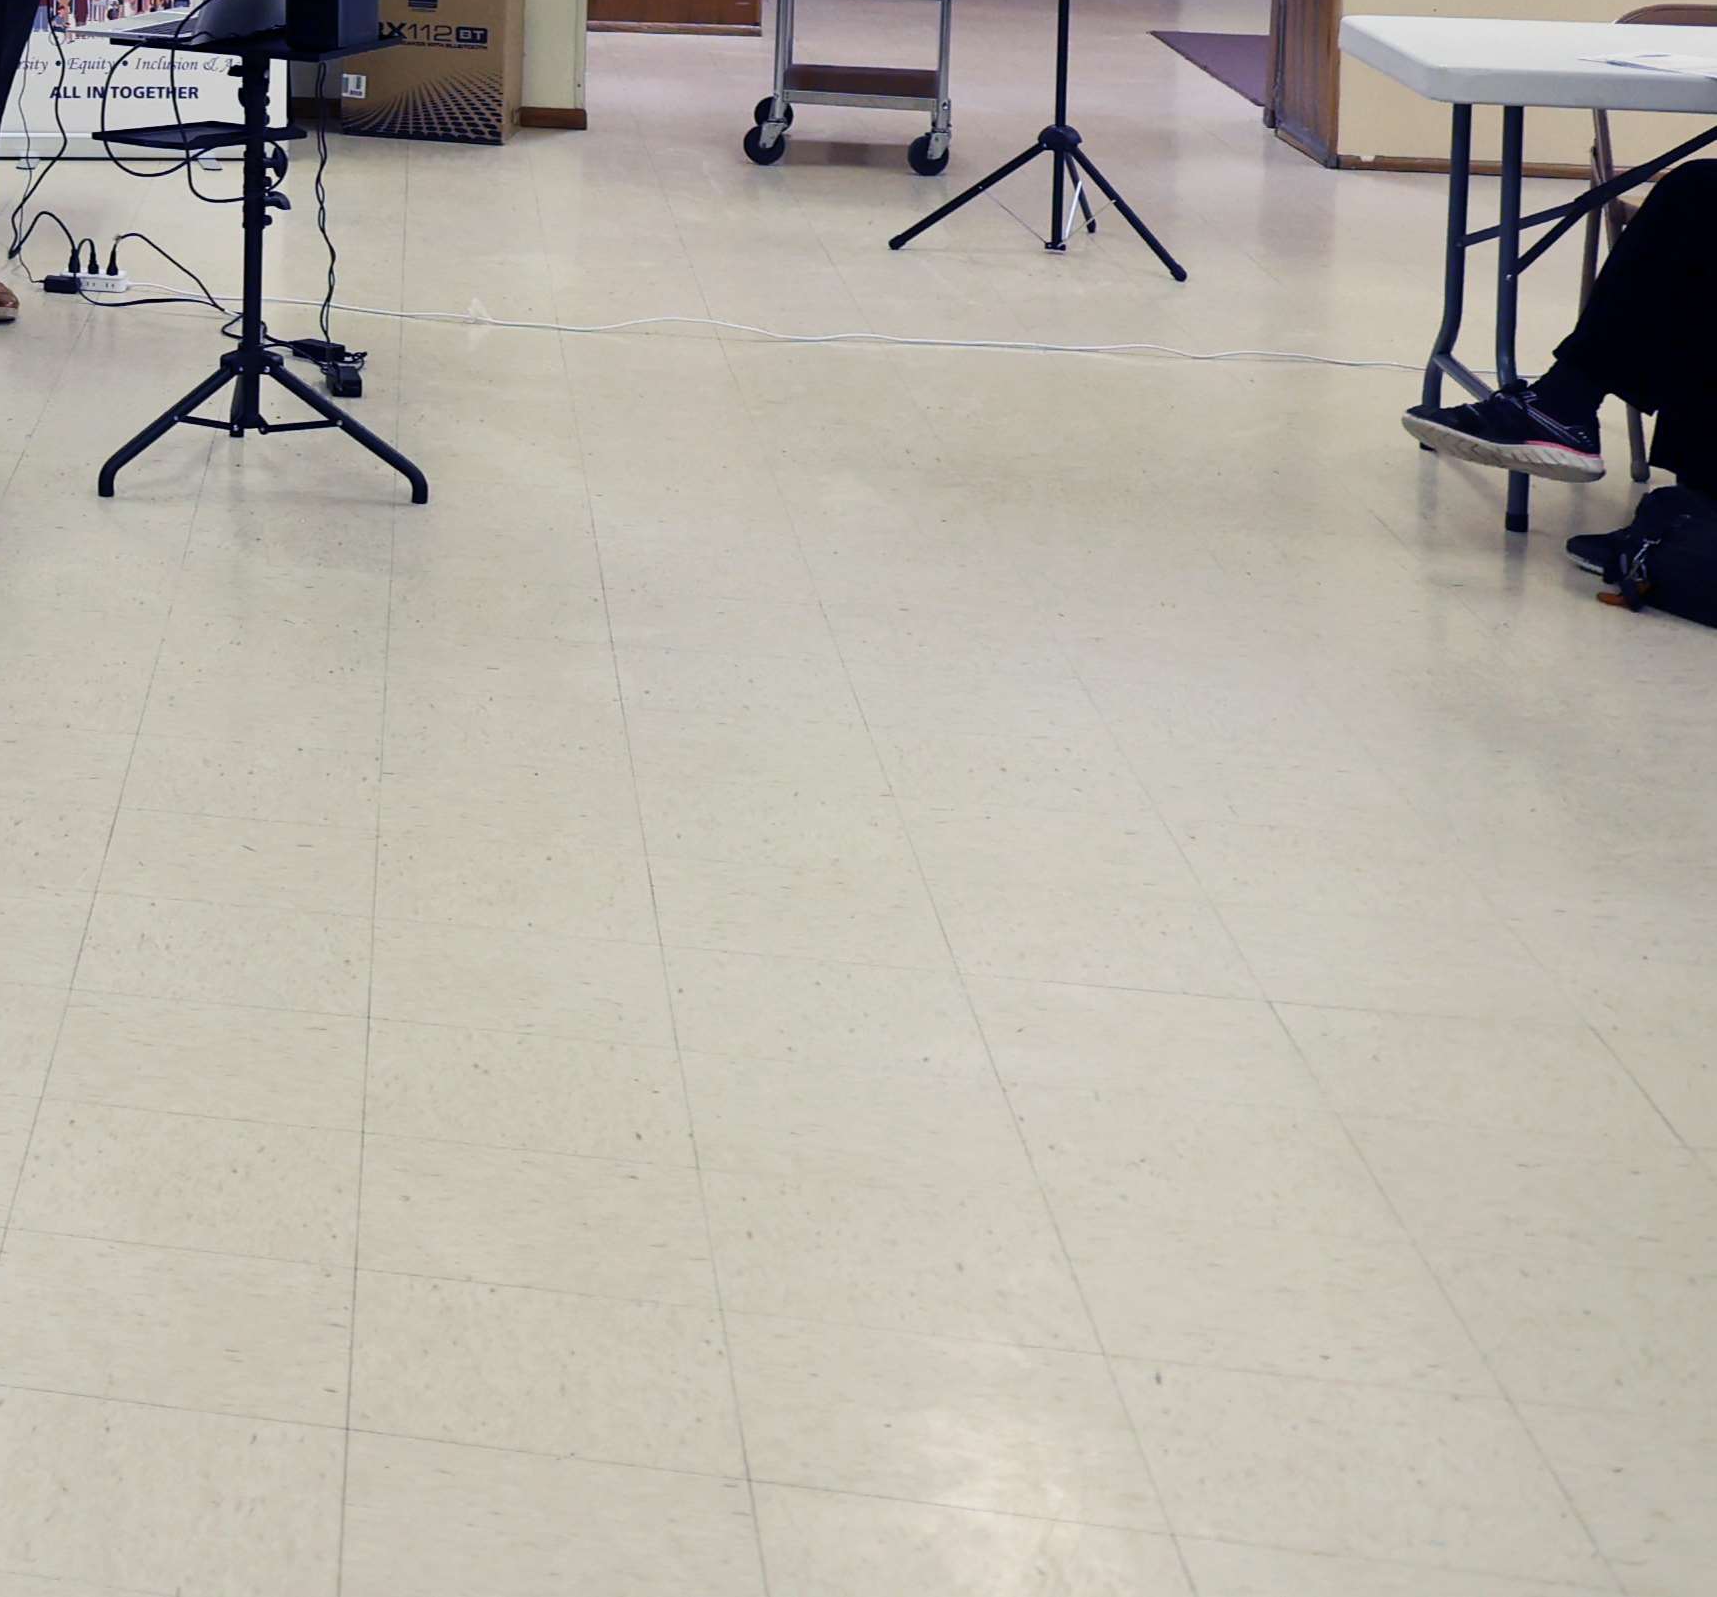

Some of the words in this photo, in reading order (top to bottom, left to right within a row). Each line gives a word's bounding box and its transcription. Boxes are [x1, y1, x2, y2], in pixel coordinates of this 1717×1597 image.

[67, 57, 115, 75] Equity
[135, 57, 199, 71] Inclusion
[49, 86, 81, 99] ALL
[86, 86, 105, 99] IN
[110, 86, 199, 99] TOGETHER
